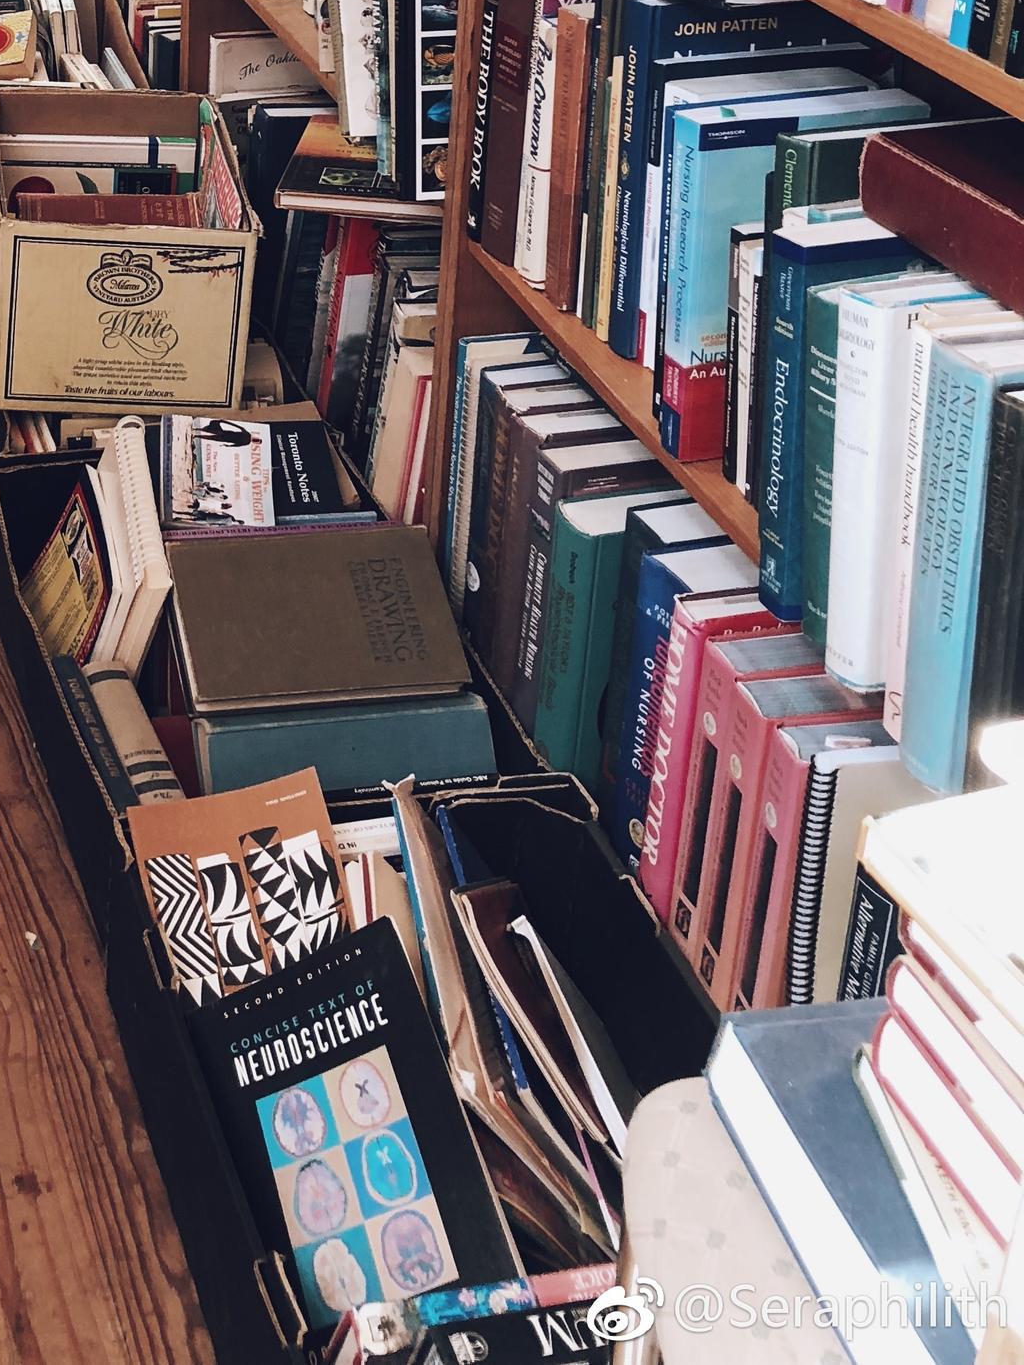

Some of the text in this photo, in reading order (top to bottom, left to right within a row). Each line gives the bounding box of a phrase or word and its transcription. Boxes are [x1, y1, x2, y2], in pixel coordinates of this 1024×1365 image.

[481, 11, 495, 62] THE
[674, 16, 778, 37] JOHN PATTEN
[475, 62, 492, 129] BODY
[620, 45, 637, 253] JOHN PATTEN Neurological
[677, 144, 695, 272] Nursing Research
[93, 266, 157, 286] BROWN BROTHERS
[123, 287, 157, 303] AUSTRALIA
[98, 309, 179, 361] White
[84, 386, 97, 394] the
[97, 386, 118, 395] fruits
[690, 367, 706, 379] An
[287, 431, 311, 503] Toronto Notes
[759, 357, 791, 518] Endocrinology
[901, 340, 926, 551] natural health handbook
[252, 477, 265, 523] WEIGHT
[367, 557, 416, 663] DRAWING
[631, 656, 656, 772] OF NURSING
[640, 619, 690, 867] HOME DOCTOR
[849, 896, 875, 977] Alternative
[221, 946, 364, 1021] SECOND EDITION
[228, 977, 378, 1055] CONCISE TEXT OF
[232, 992, 390, 1089] NEUROSCIENCE
